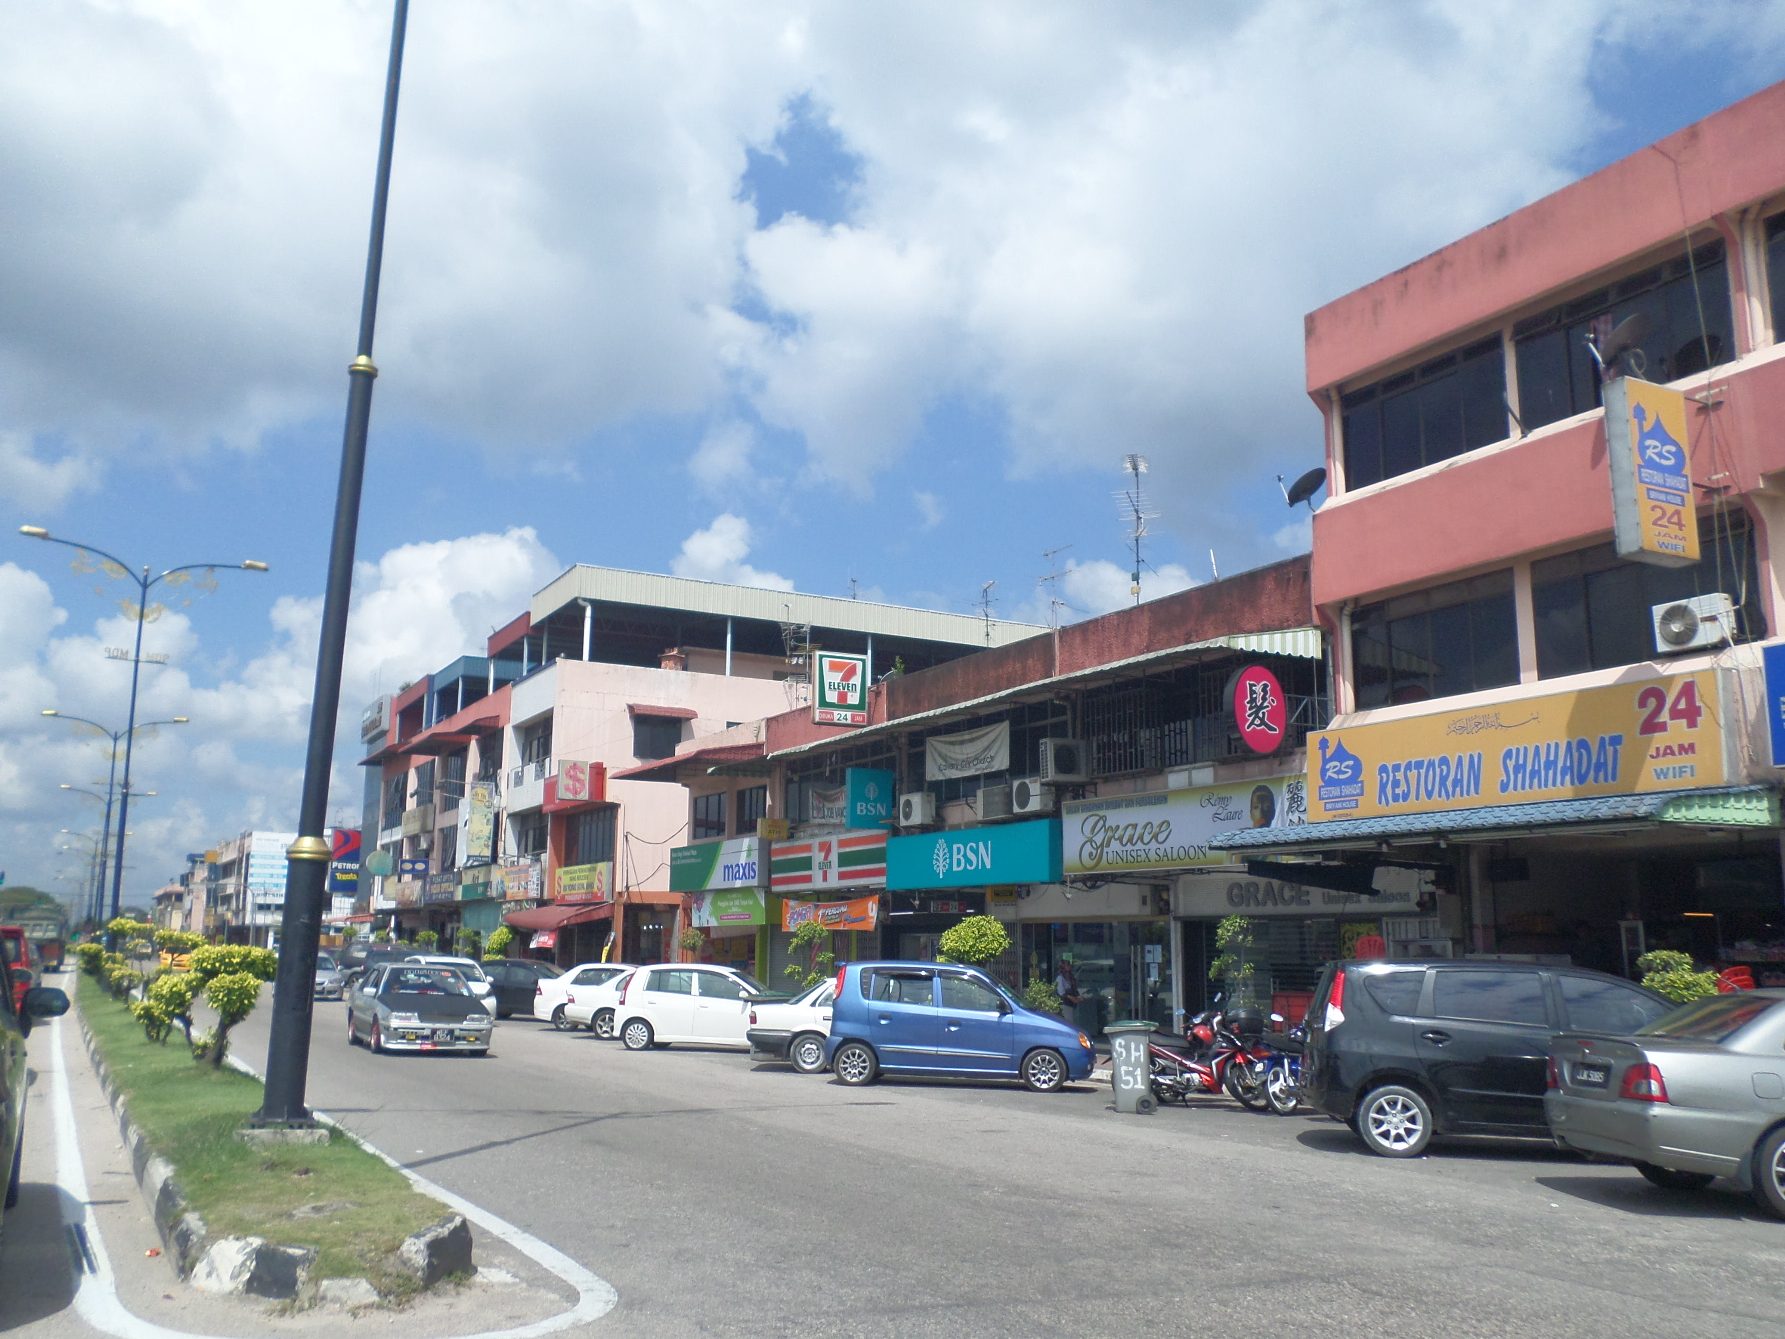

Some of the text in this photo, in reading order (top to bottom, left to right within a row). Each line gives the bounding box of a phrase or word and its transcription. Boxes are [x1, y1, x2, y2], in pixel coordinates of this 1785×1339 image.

[1644, 439, 1677, 466] RS
[1651, 504, 1686, 531] 24
[1654, 531, 1687, 542] JAM
[1657, 541, 1685, 553] WIFI
[828, 660, 857, 704] 7
[837, 713, 848, 721] 24
[1637, 680, 1702, 735] 24
[1649, 742, 1696, 760] JAM
[1325, 760, 1354, 780] RS
[1377, 734, 1623, 807] RESTORAN SHAHADAT
[1652, 763, 1695, 781] WIFI
[856, 802, 886, 816] BSN
[1079, 813, 1173, 870] Grace
[818, 841, 832, 882] 7
[952, 840, 992, 871] BSN
[1106, 844, 1208, 865] UNISEX SALOON
[723, 860, 757, 882] maxis
[1226, 881, 1311, 909] GRACE
[1120, 1066, 1145, 1090] 51
